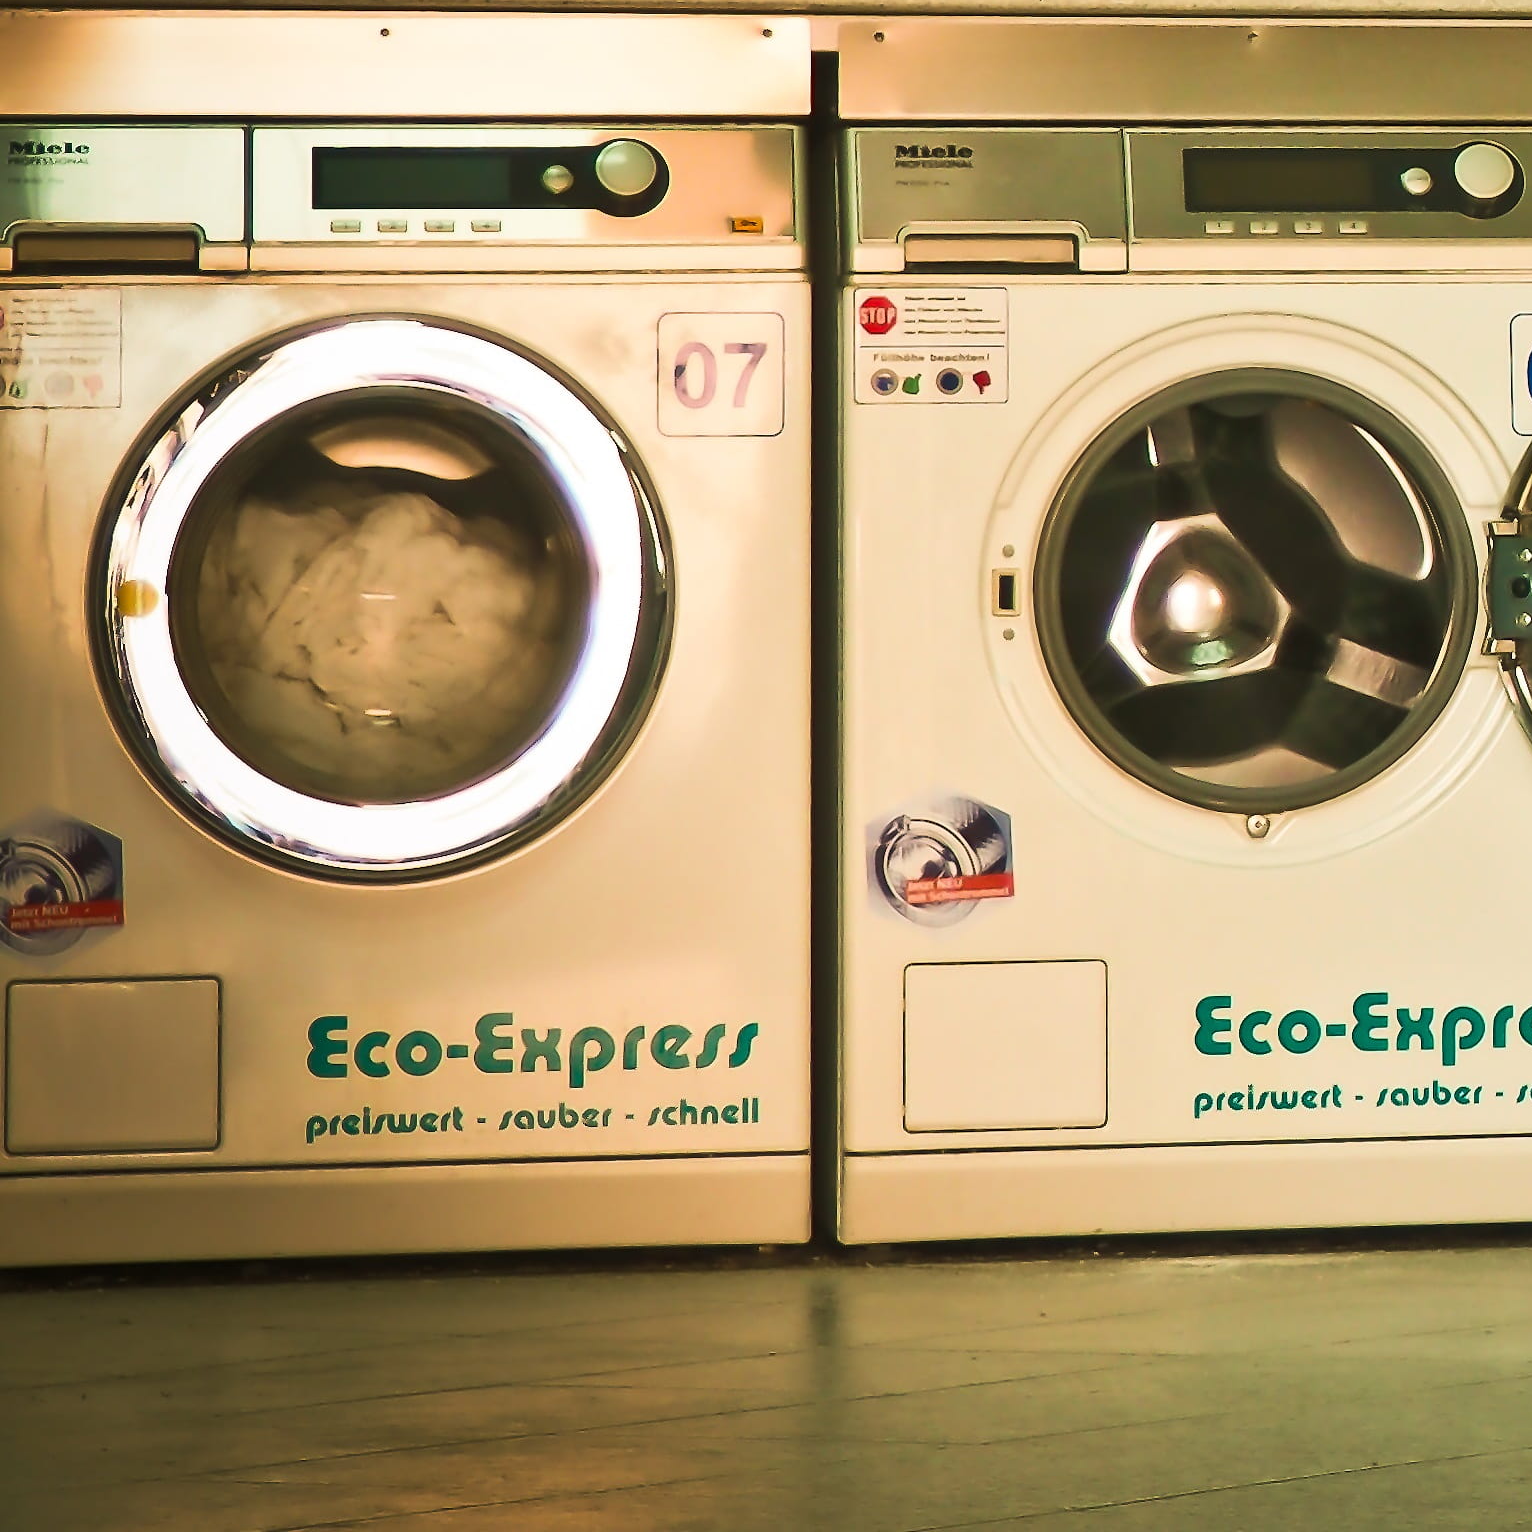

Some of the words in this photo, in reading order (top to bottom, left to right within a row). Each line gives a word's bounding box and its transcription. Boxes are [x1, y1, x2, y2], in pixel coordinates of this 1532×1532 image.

[9, 140, 90, 154] Miele
[895, 144, 974, 158] Miele
[859, 307, 897, 325] STOP
[673, 340, 768, 408] 07
[307, 1012, 759, 1087] Eco-Express
[1194, 1085, 1342, 1118] preiswert
[1377, 1080, 1483, 1106] sauber
[306, 1105, 463, 1143] preiswert
[498, 1102, 612, 1129] sauber
[647, 1097, 760, 1125] schnell
